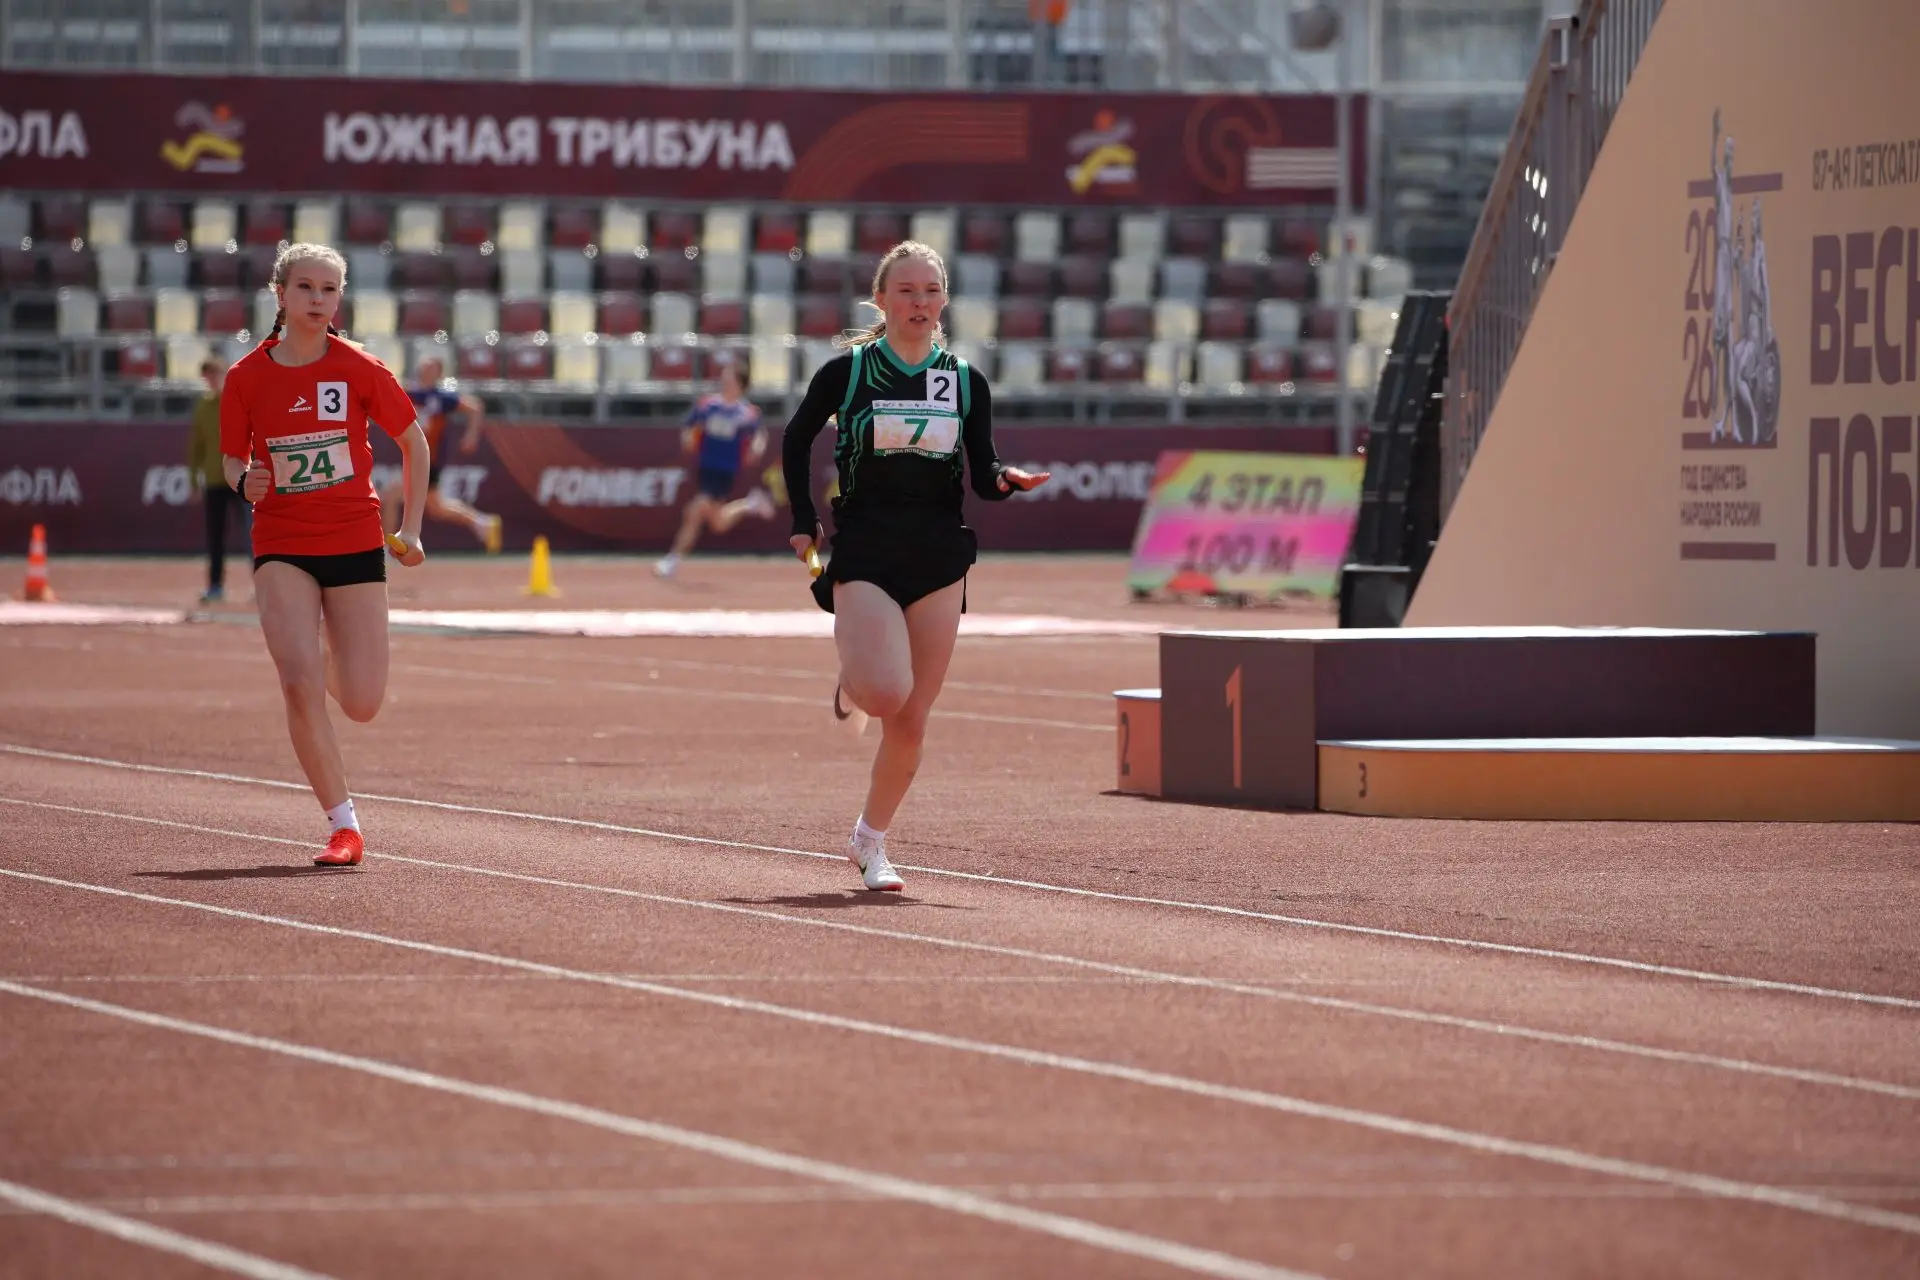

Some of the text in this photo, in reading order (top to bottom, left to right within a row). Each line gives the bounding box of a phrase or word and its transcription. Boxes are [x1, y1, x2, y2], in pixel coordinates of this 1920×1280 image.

[324, 113, 795, 170] ЮЖНАЯ ТРИБУНА
[324, 388, 341, 414] 3
[933, 376, 950, 402] 2
[904, 418, 929, 445] 7
[287, 450, 335, 484] 24
[904, 448, 928, 457] ПОБЕДЫ
[538, 467, 684, 506] FONBET
[1188, 472, 1326, 515] 4 ЭТАП
[1807, 413, 1920, 570] ПОБ
[1178, 532, 1256, 574] 100
[1119, 711, 1130, 776] 2
[1225, 664, 1242, 789] 1
[1358, 762, 1368, 798] 3
